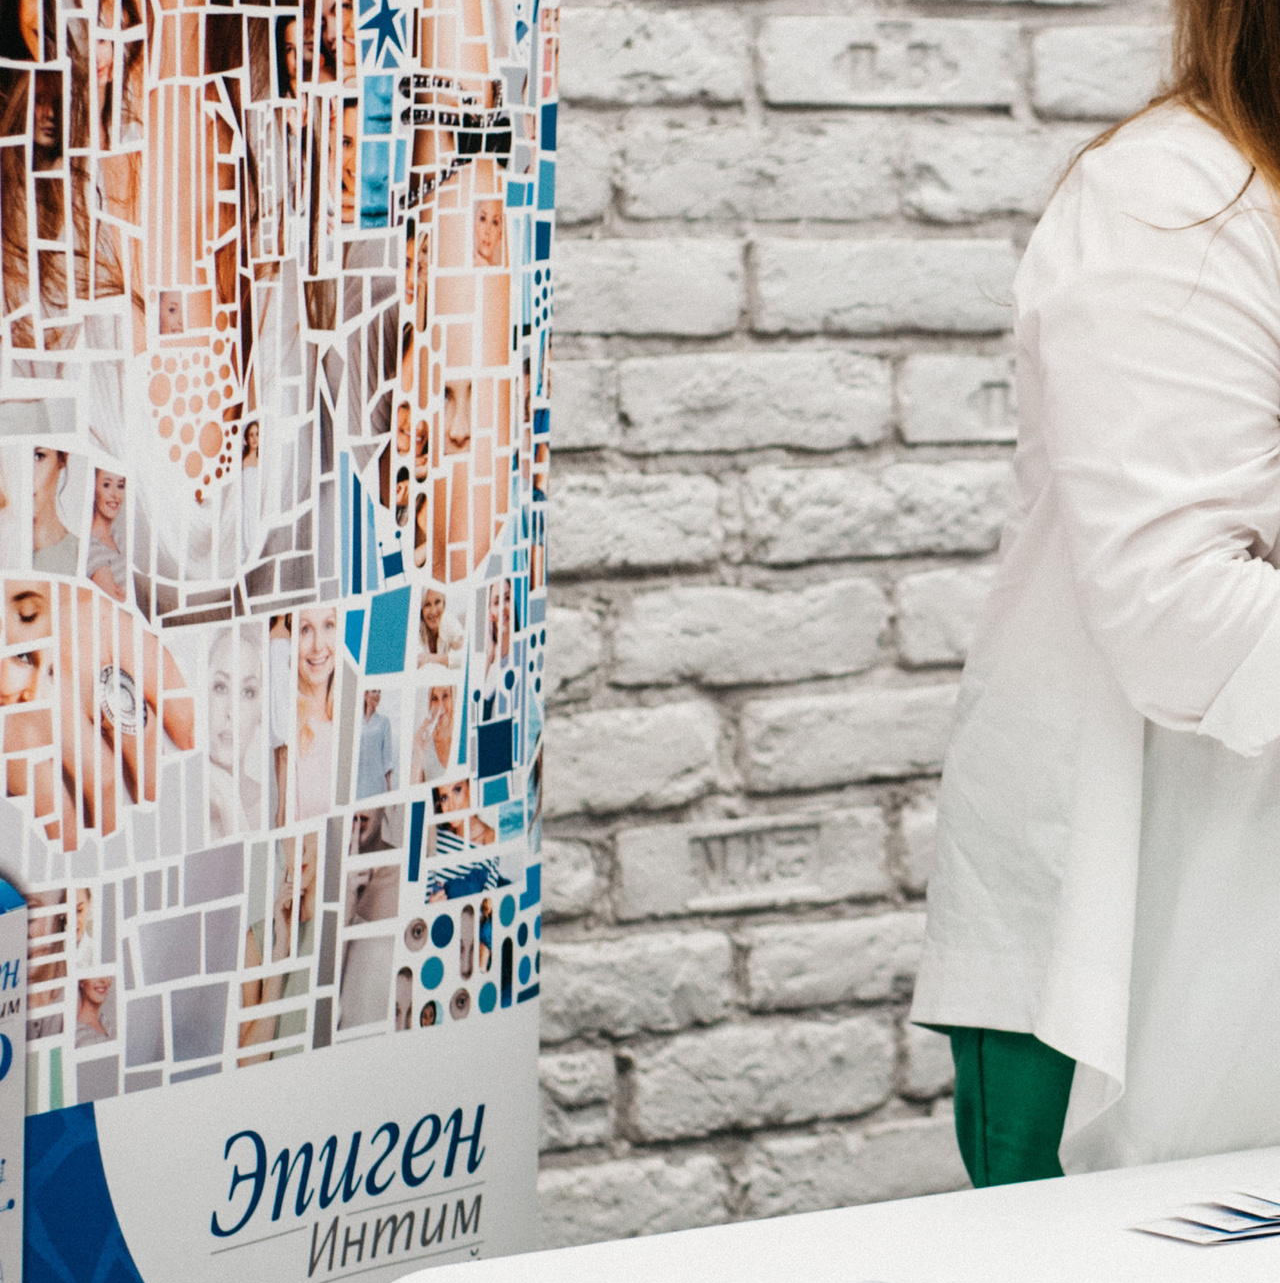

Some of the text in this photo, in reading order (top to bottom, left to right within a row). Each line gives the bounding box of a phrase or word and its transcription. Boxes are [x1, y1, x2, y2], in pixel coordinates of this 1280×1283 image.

[0, 958, 20, 991] н
[210, 1103, 486, 1238] Эпиген
[307, 1193, 483, 1279] Интим
